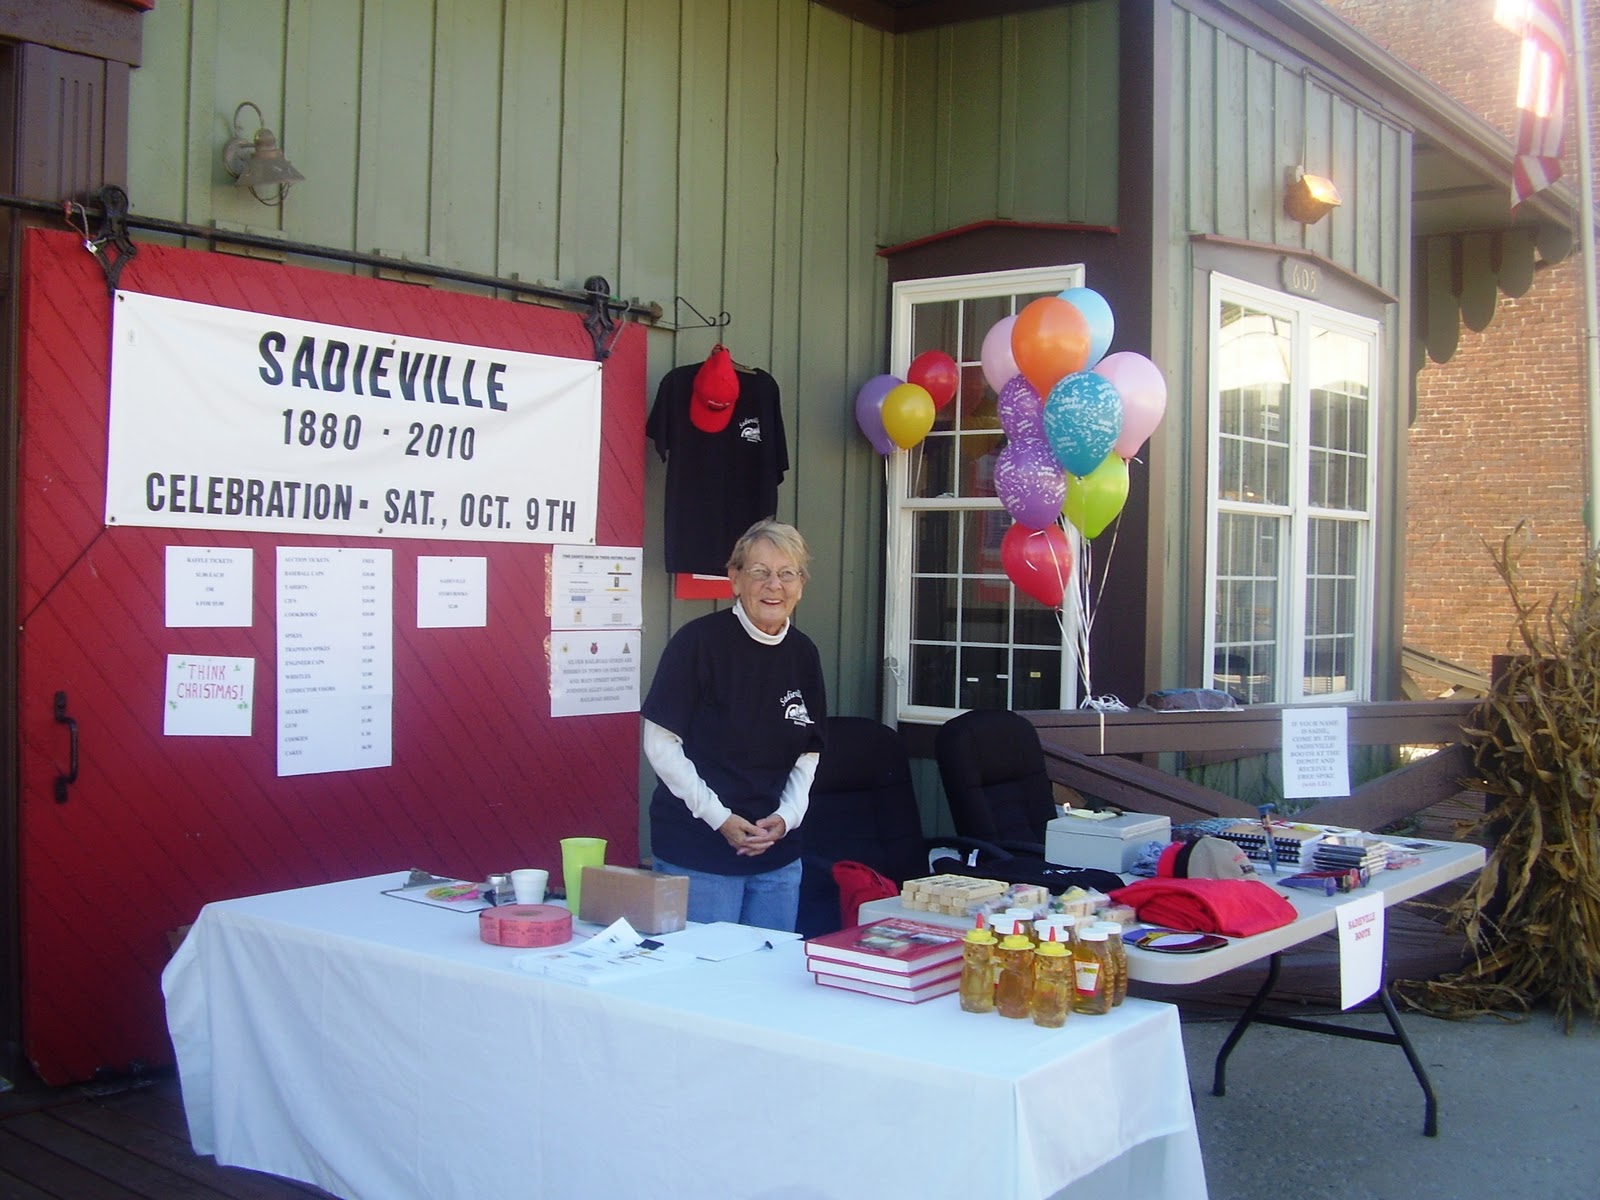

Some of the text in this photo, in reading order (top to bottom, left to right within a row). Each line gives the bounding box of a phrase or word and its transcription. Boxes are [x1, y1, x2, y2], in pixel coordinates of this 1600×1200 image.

[259, 331, 508, 412] SADIEVILLE
[282, 408, 362, 451] 1880
[405, 421, 477, 461] 2010
[460, 492, 512, 530] OCT.
[526, 496, 577, 533] 9TH
[188, 663, 226, 681] THINK
[177, 682, 244, 700] CHRISTMAS!
[1348, 911, 1375, 929] SADIEVILLE
